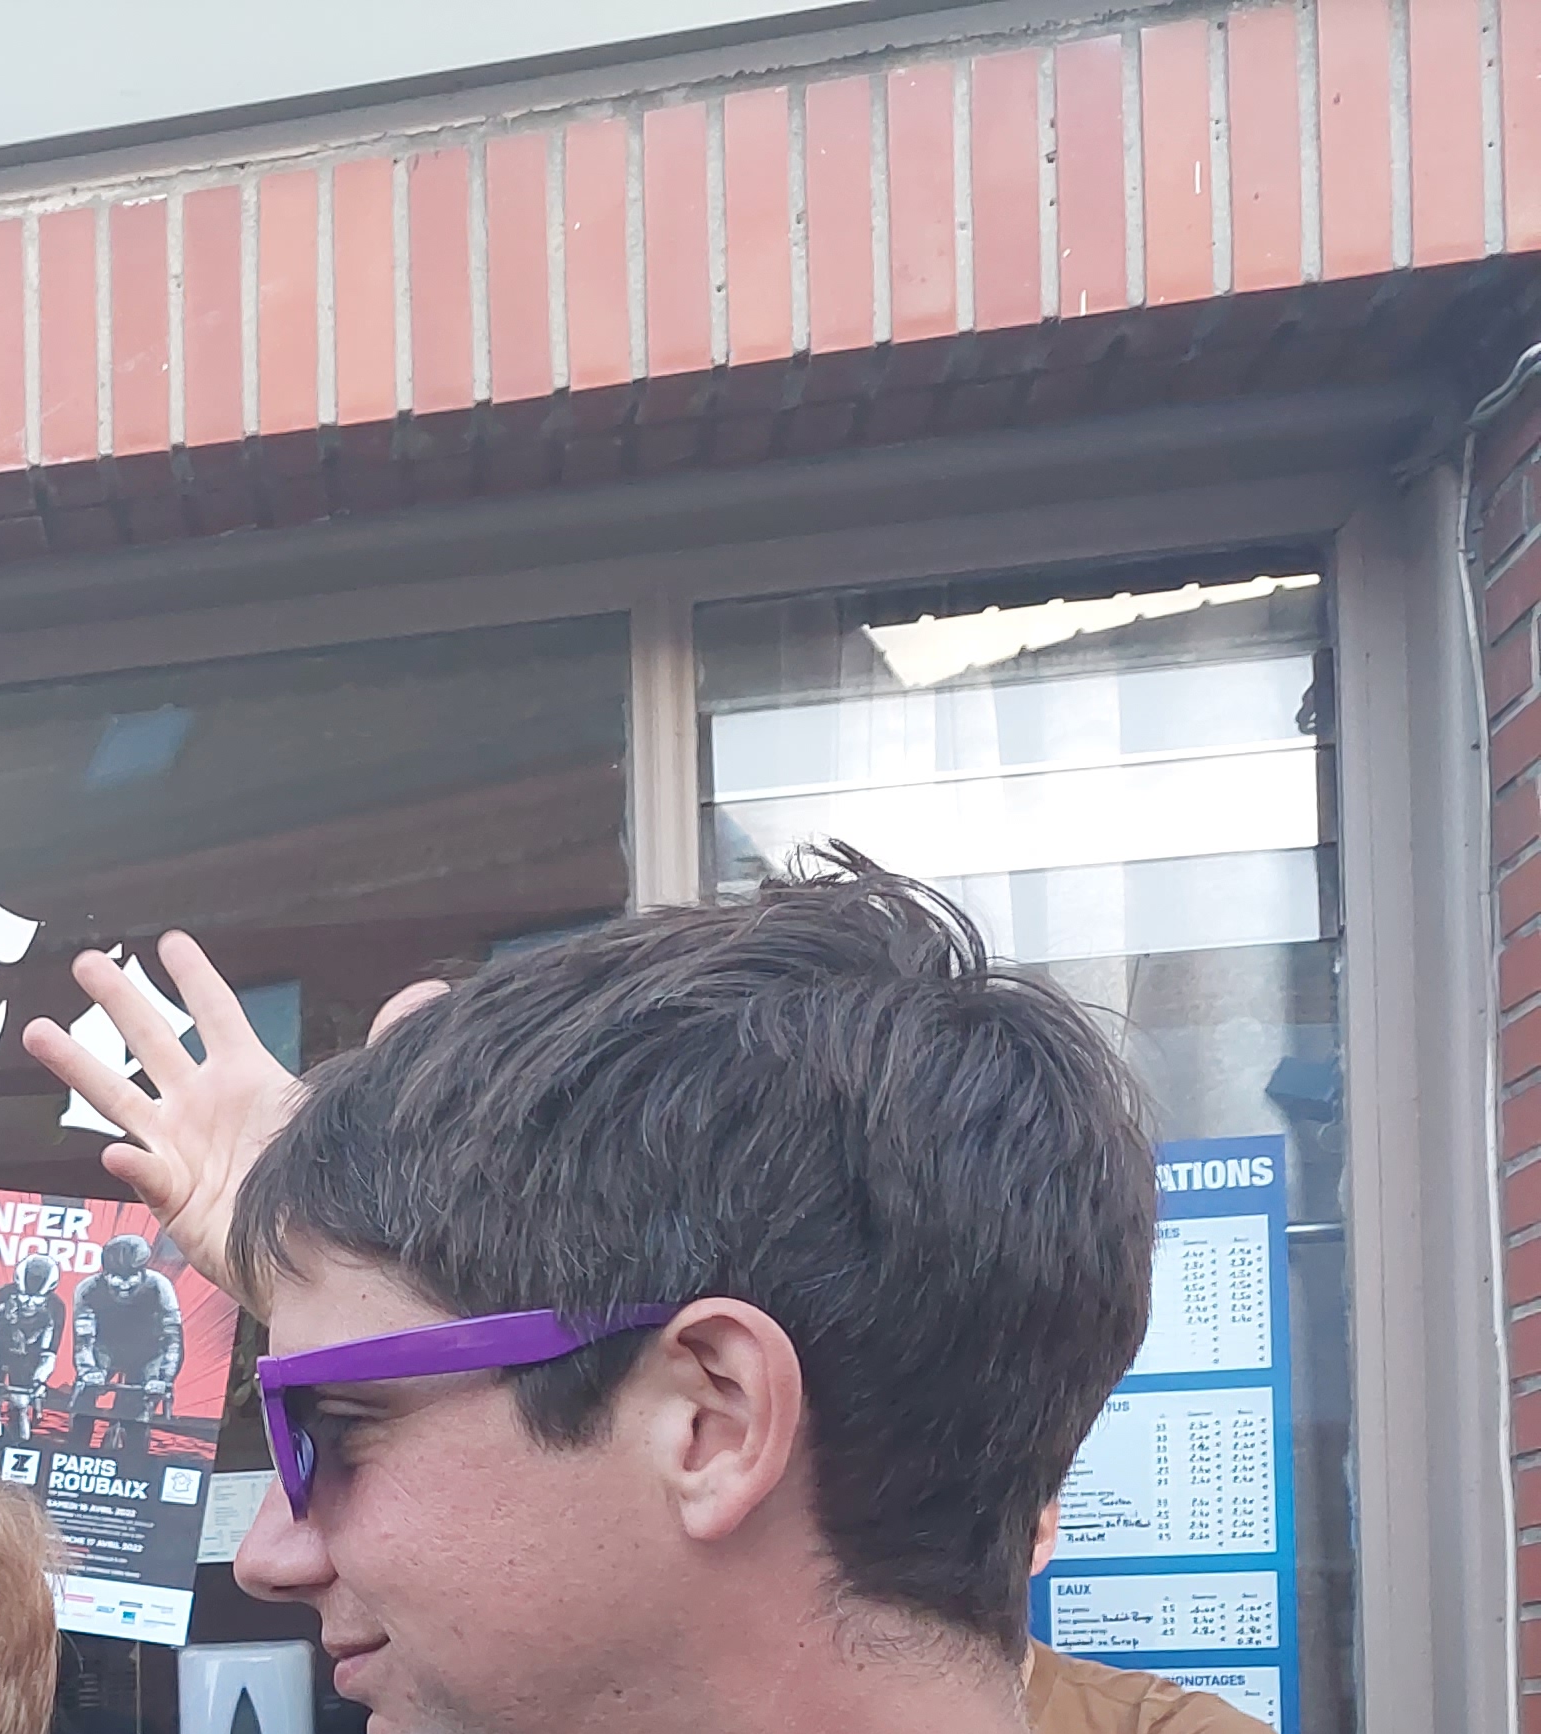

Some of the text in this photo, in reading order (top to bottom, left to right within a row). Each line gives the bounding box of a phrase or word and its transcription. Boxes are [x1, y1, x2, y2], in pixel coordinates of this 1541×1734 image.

[1156, 1156, 1274, 1192] ATIONS
[52, 1453, 117, 1477] PARIS
[48, 1471, 150, 1500] ROUBAIX
[1056, 1583, 1093, 1596] EAUX
